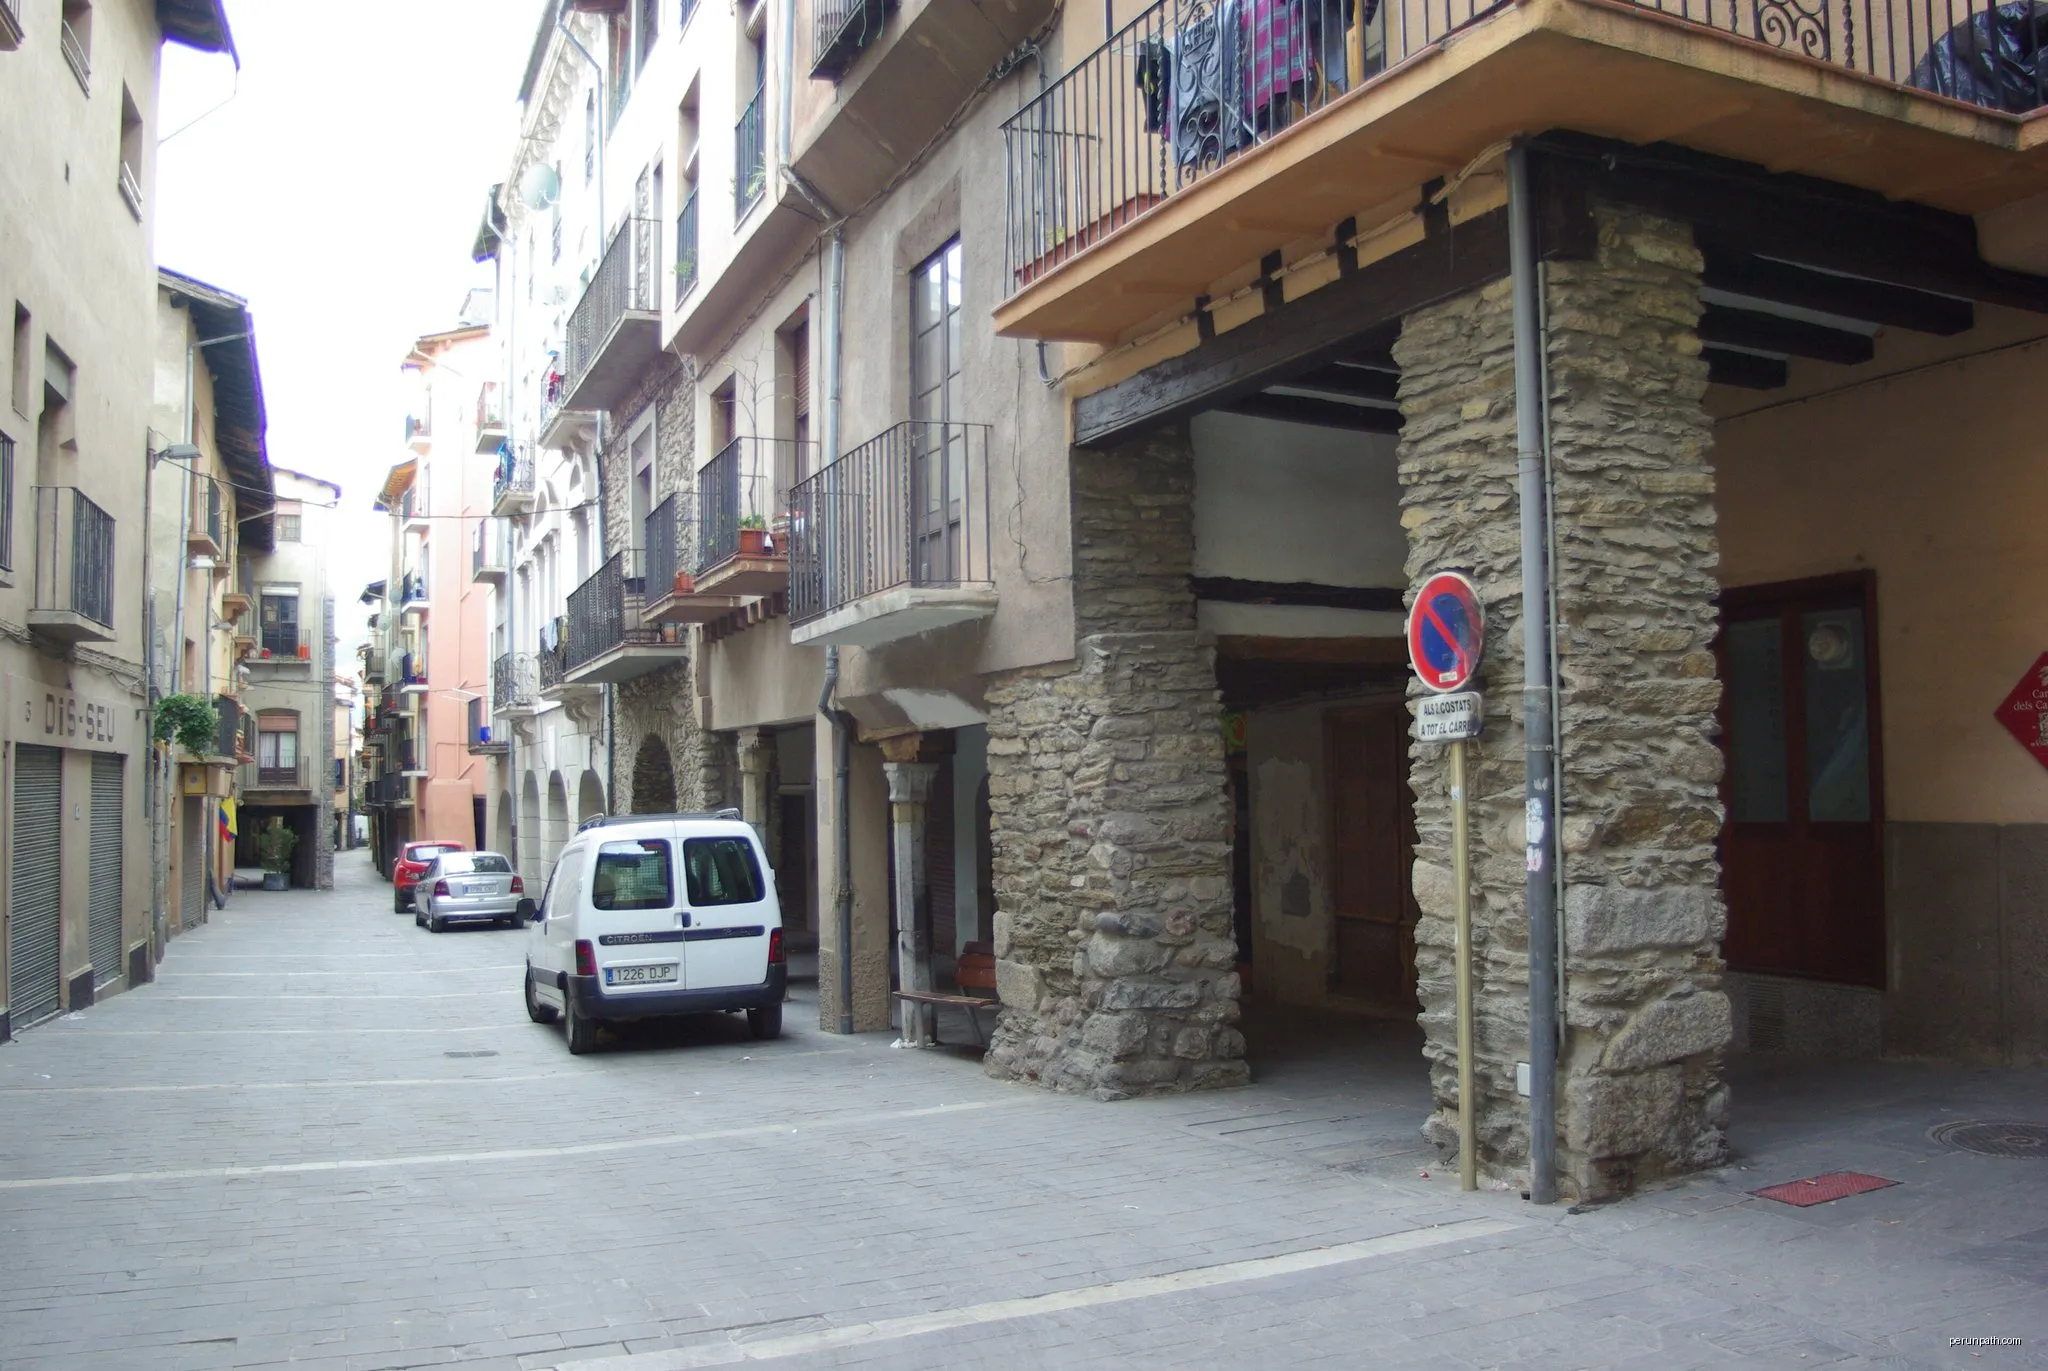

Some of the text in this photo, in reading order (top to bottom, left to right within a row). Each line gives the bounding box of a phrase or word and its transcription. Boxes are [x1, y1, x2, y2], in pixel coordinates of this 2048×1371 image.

[1424, 703, 1435, 716] ALS
[1440, 699, 1471, 714] COSTATS
[2013, 700, 2032, 710] dels
[1421, 724, 1425, 736] A
[1427, 723, 1438, 736] TOT
[1439, 722, 1447, 734] EL
[617, 966, 670, 981] 1226 DJP
